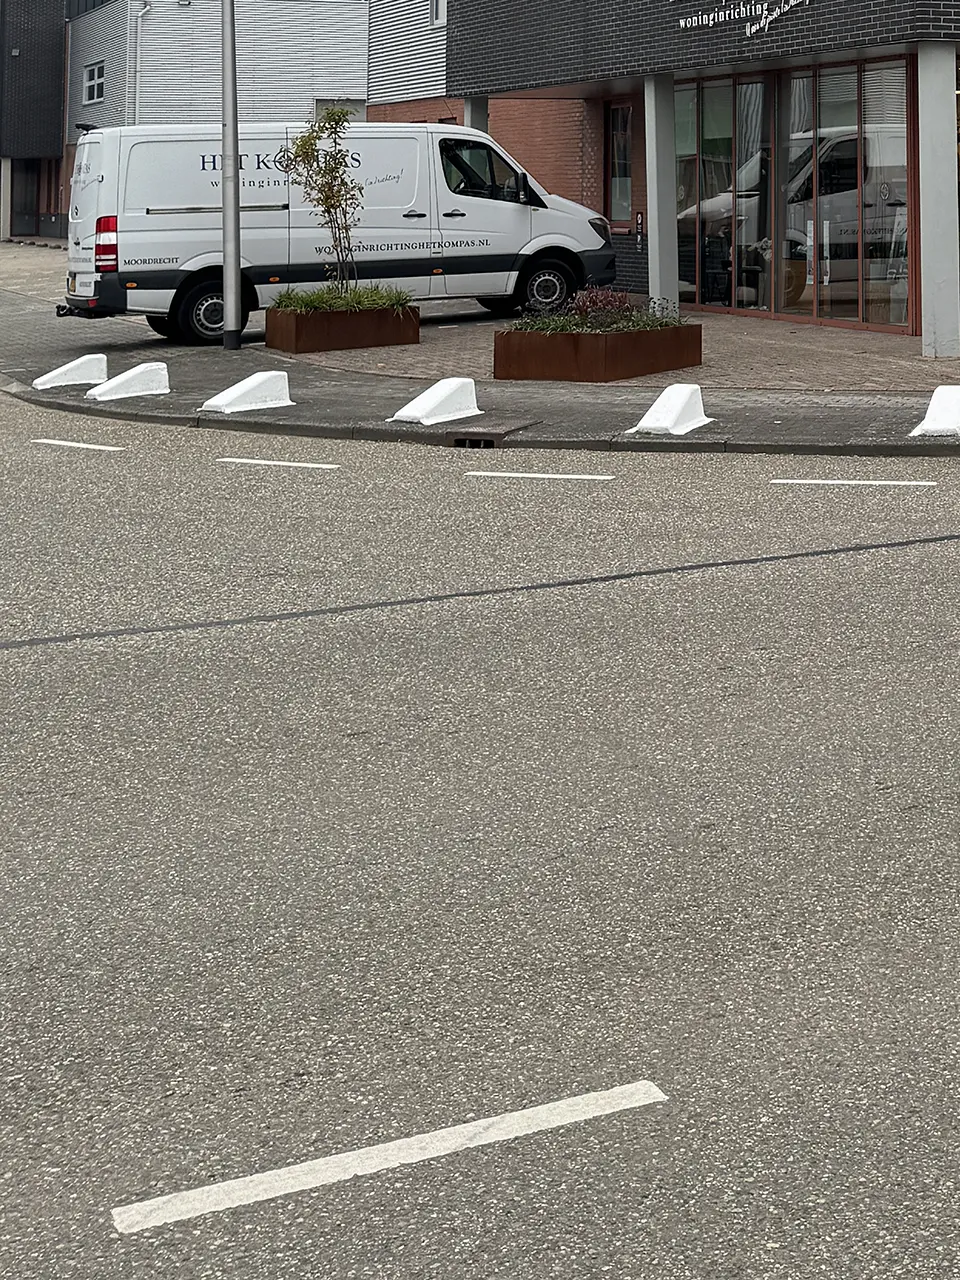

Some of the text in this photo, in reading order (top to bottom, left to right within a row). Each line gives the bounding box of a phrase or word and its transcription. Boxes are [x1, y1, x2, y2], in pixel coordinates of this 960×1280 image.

[679, 0, 769, 29] woninginrichting
[200, 153, 249, 171] HT
[123, 257, 180, 266] MOORDRECHT
